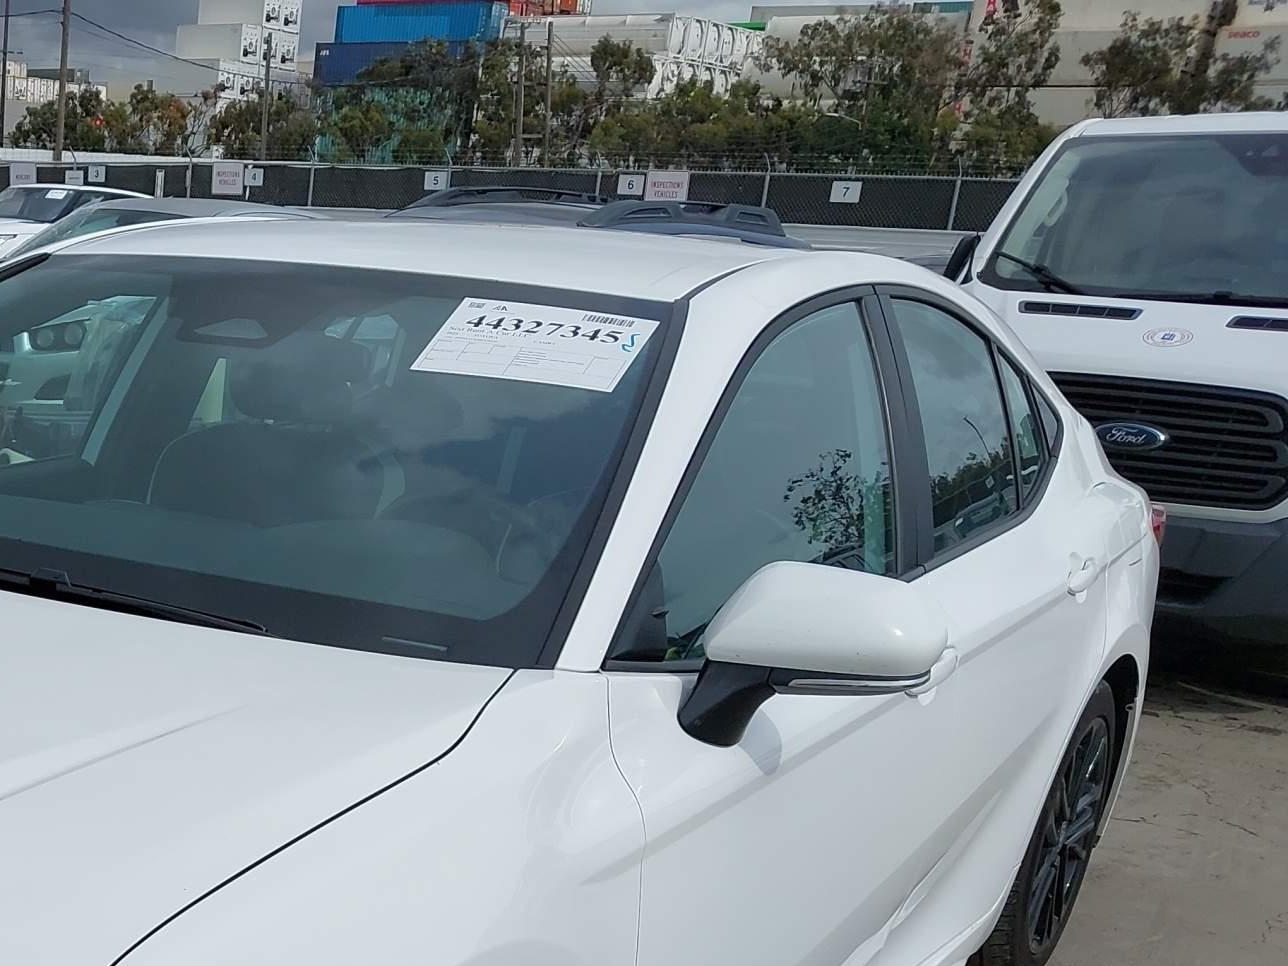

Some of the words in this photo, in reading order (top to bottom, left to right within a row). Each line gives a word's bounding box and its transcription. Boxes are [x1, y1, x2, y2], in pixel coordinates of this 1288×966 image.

[94, 169, 99, 178] 3
[251, 172, 257, 181] 4
[433, 176, 439, 185] 5
[627, 180, 634, 190] 6
[842, 187, 850, 197] 7
[466, 315, 624, 344] 44327345
[1106, 427, 1146, 445] Ford
